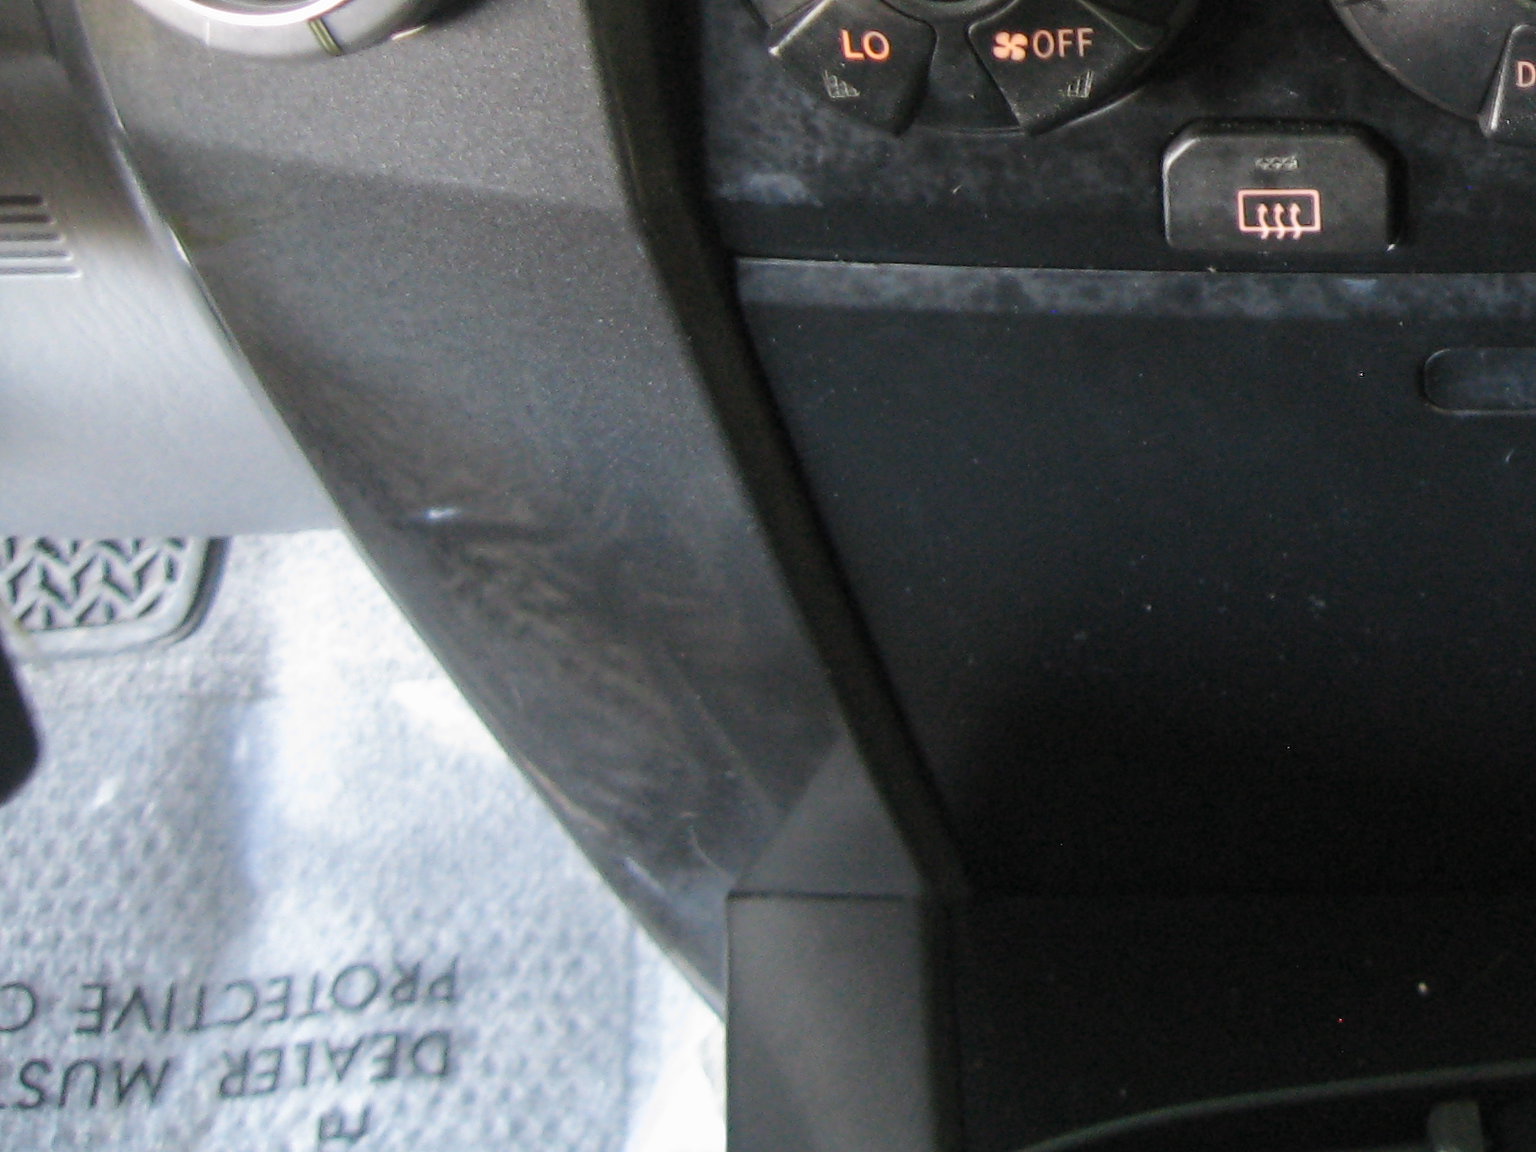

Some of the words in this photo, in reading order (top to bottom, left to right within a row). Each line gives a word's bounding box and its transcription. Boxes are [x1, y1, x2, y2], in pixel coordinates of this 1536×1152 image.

[840, 28, 891, 63] LO
[1032, 26, 1095, 60] OFF
[75, 955, 460, 1035] PROTECTIVE
[0, 1058, 171, 1110] MUS
[217, 1029, 452, 1099] DEALER
